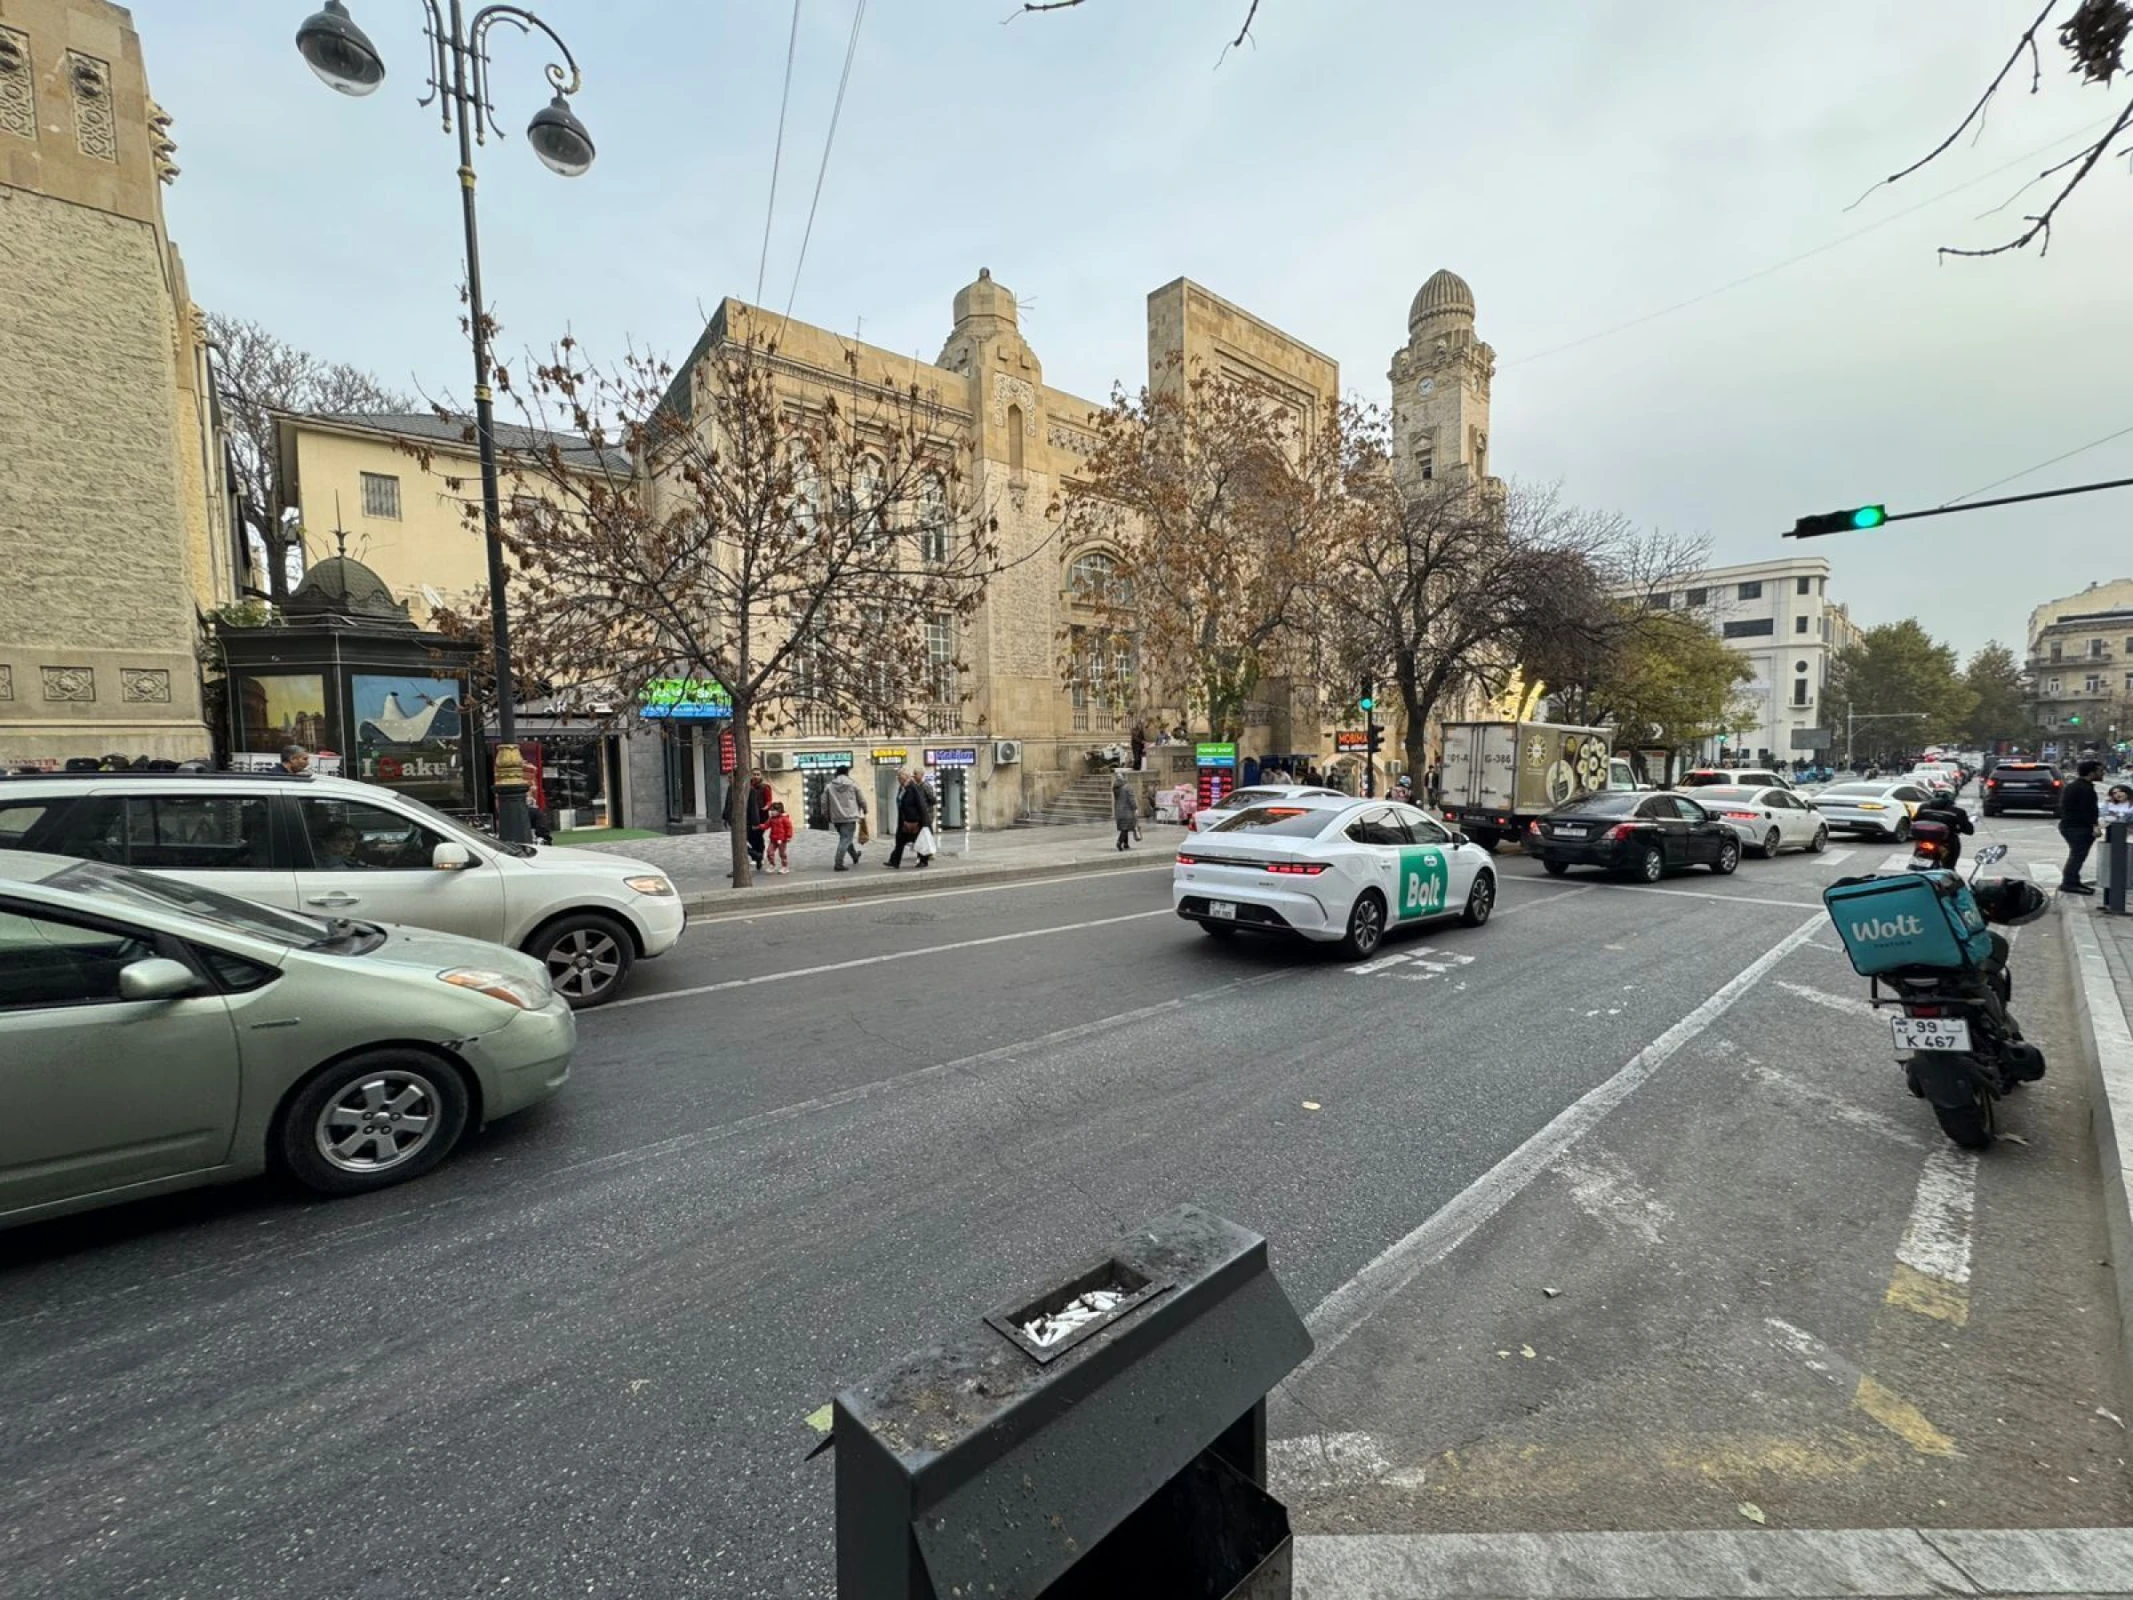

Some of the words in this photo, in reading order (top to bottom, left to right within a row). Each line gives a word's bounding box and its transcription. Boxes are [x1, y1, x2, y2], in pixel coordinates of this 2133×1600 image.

[1406, 871, 1441, 908] Bolt
[1851, 914, 1924, 941] Wolt
[1915, 1020, 1938, 1033] 99
[1905, 1035, 1919, 1048] K
[1924, 1035, 1956, 1048] 467
